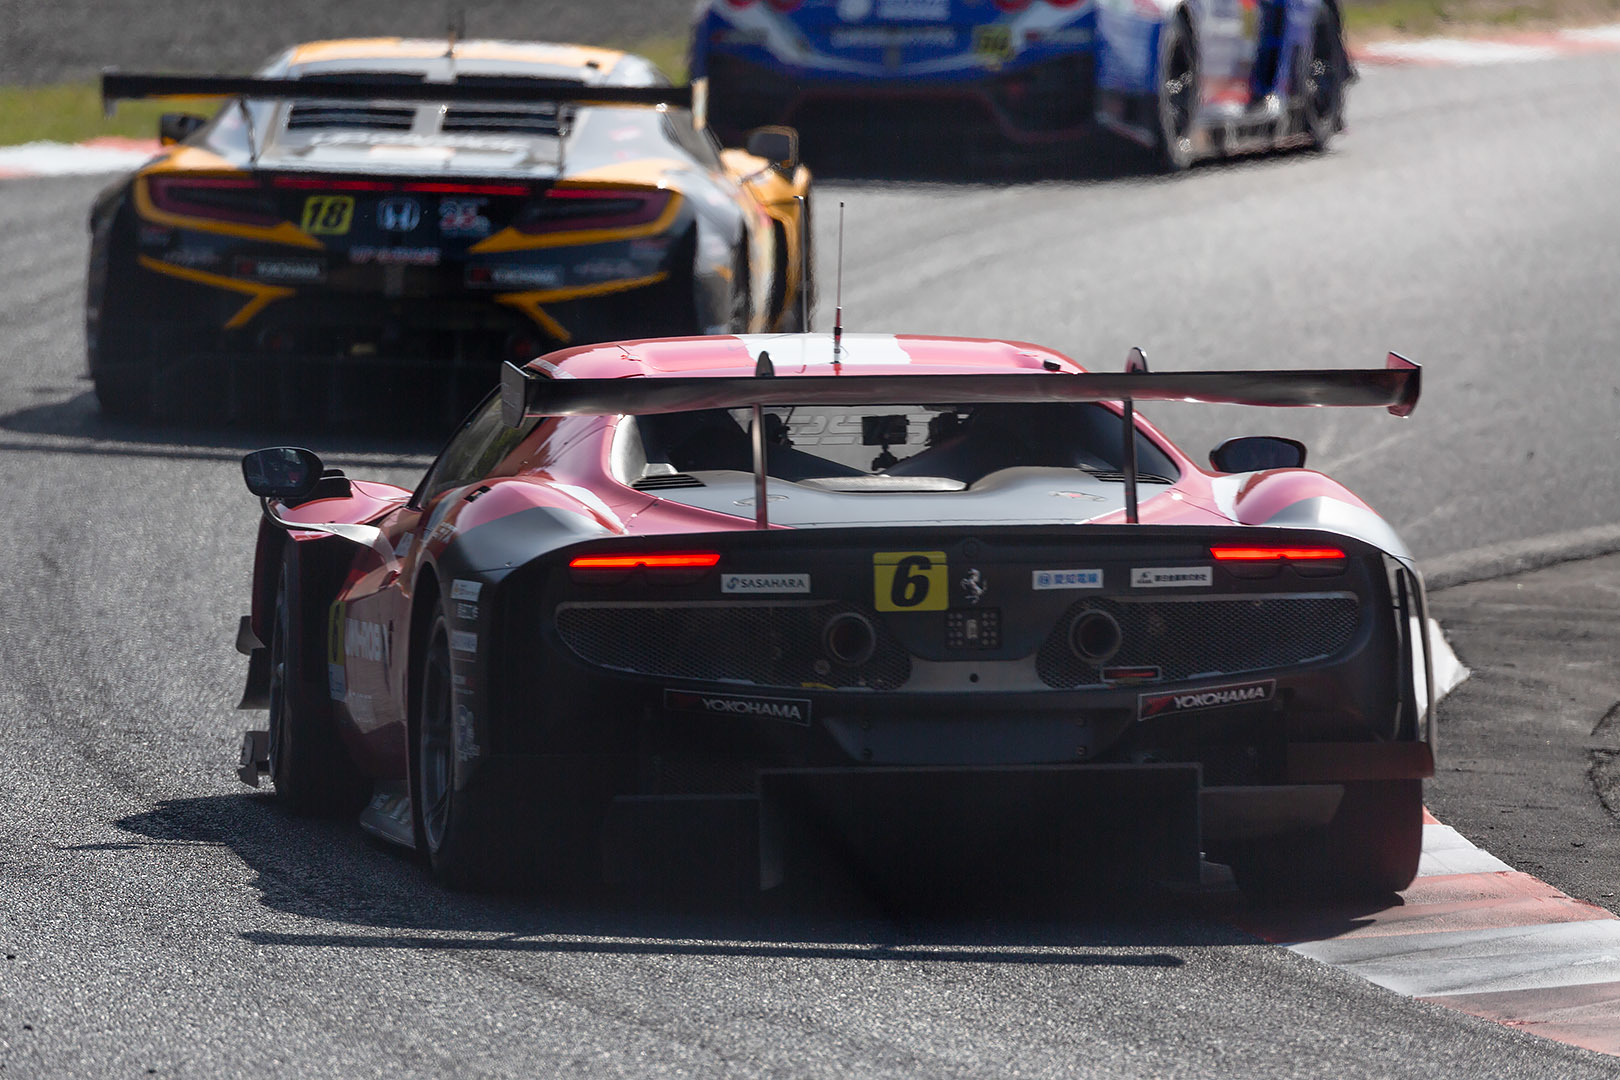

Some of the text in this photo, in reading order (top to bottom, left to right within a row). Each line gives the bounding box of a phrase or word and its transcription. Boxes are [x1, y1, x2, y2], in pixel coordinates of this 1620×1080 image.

[309, 200, 349, 228] 18
[740, 577, 806, 589] SASAHARA
[892, 555, 931, 606] 6
[1174, 687, 1265, 709] YOKOHAMA
[703, 699, 801, 720] YOKOHAMA
